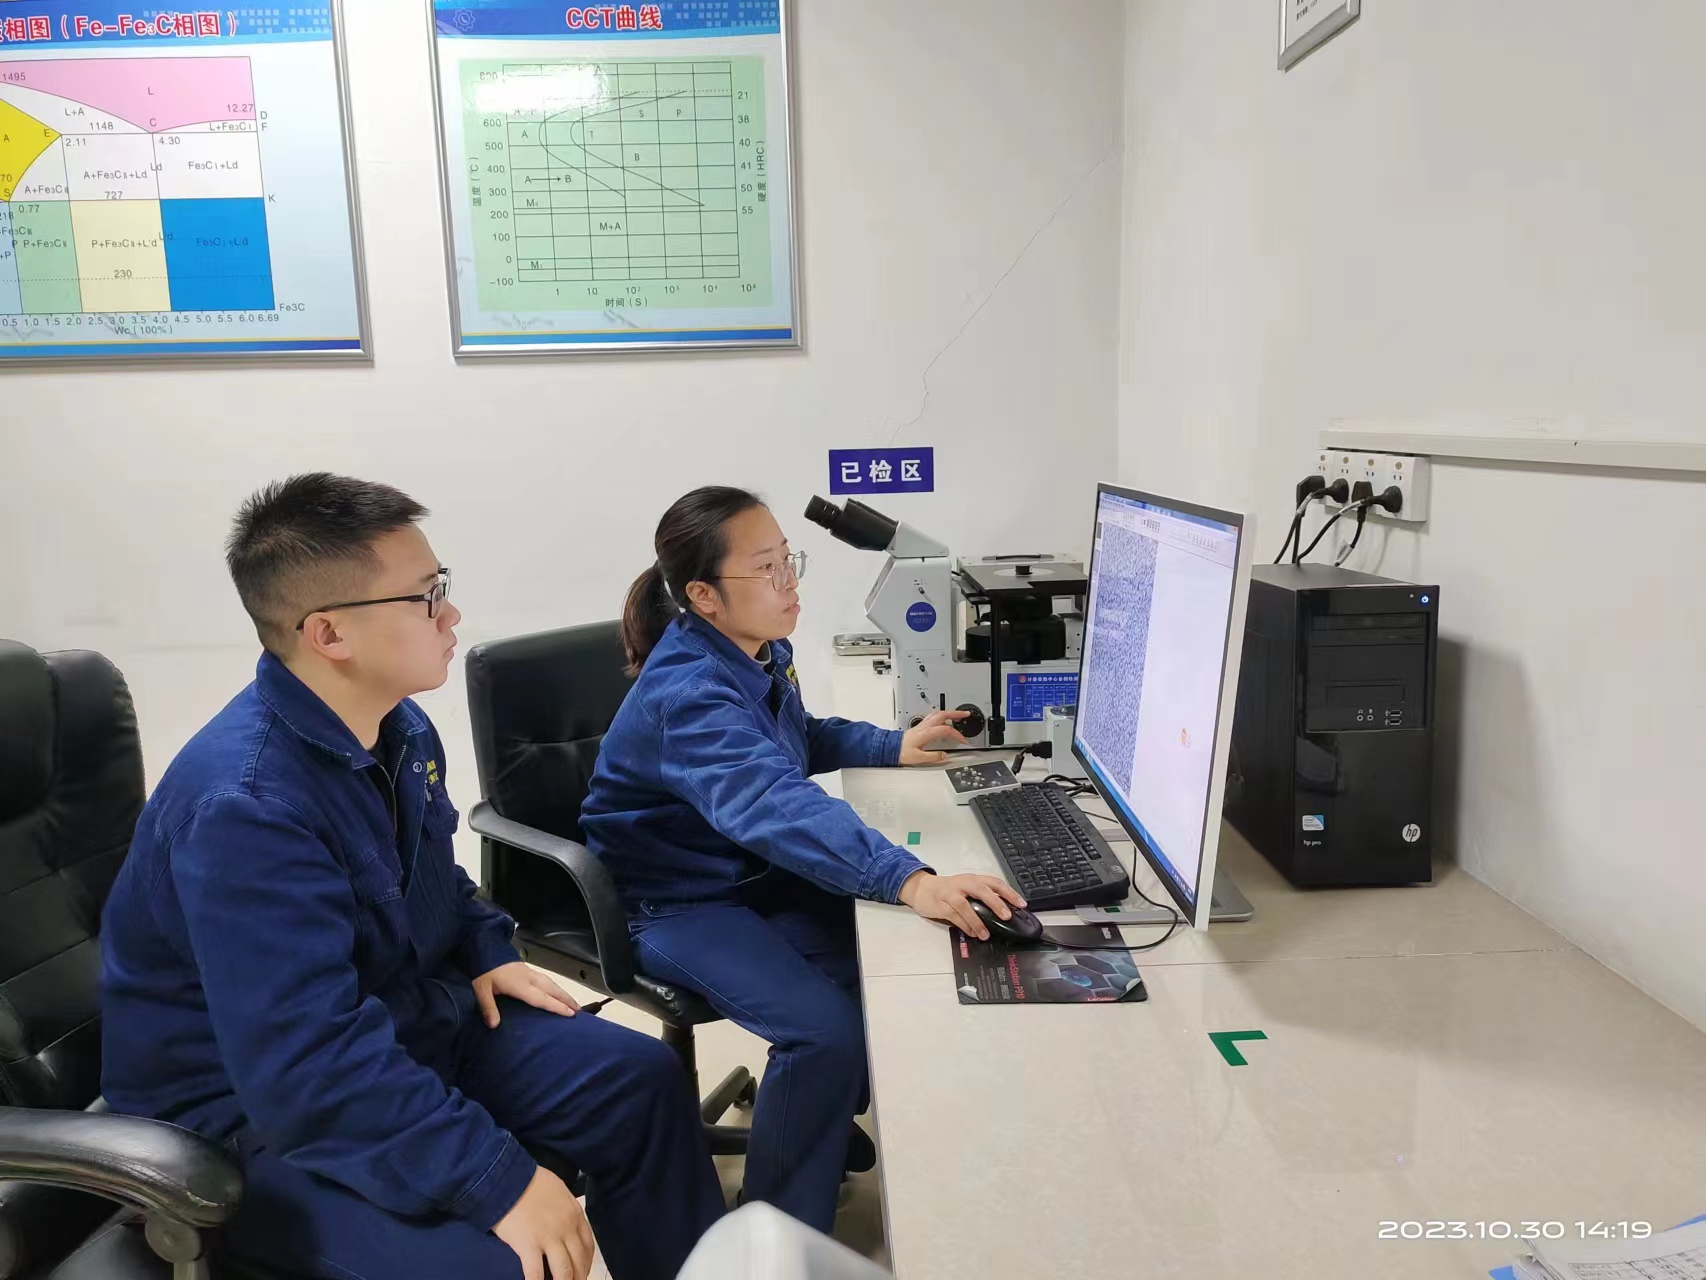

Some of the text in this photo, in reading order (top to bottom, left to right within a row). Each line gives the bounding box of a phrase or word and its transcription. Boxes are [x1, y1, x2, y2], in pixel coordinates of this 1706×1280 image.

[565, 5, 663, 30] CCT曲线
[3, 72, 26, 81] 1495
[148, 87, 154, 96] L
[737, 91, 748, 99] 21
[65, 108, 85, 116] L+A
[227, 104, 254, 113] 12.27
[260, 111, 268, 120] D
[638, 110, 645, 118] S
[676, 109, 682, 117] P
[149, 118, 157, 127] C
[483, 119, 502, 127] 600
[738, 115, 750, 123] 38
[90, 122, 114, 131] 1148
[261, 123, 268, 131] F
[44, 129, 51, 138] E
[521, 130, 529, 139] A
[589, 131, 595, 139] T
[3, 134, 11, 143] A
[65, 138, 87, 147] 2.11
[159, 136, 181, 145] 4.30
[485, 142, 504, 151] 500
[739, 139, 751, 147] 40
[634, 153, 640, 161] B
[487, 165, 505, 173] 400
[740, 162, 752, 170] 41
[525, 175, 571, 184] A B
[4, 188, 11, 197] S
[489, 188, 507, 196] 300
[741, 185, 753, 193] 50
[104, 191, 123, 199] 727
[268, 194, 276, 203] K
[18, 205, 40, 213] 0.77
[742, 207, 754, 215] 55
[490, 211, 509, 219] 200
[599, 223, 622, 231] M+A
[493, 233, 511, 241] 100
[114, 270, 133, 278] 230
[489, 278, 514, 286] -100
[555, 288, 560, 296] 1
[279, 303, 306, 312] Fe3C
[2, 318, 18, 327] 0.5
[24, 318, 39, 326] 1.0
[46, 318, 61, 326] 1.5
[66, 317, 82, 325] 2.0
[88, 317, 103, 325] 2.5
[109, 316, 125, 325] 3.0
[131, 316, 147, 324] 3.5
[153, 315, 168, 324] 4.0
[174, 315, 190, 323] 4.5
[196, 315, 212, 323] 5.0
[239, 314, 254, 322] 6.0
[257, 313, 279, 322] 6.69
[840, 459, 922, 483] 已检区
[1404, 824, 1419, 842] hp
